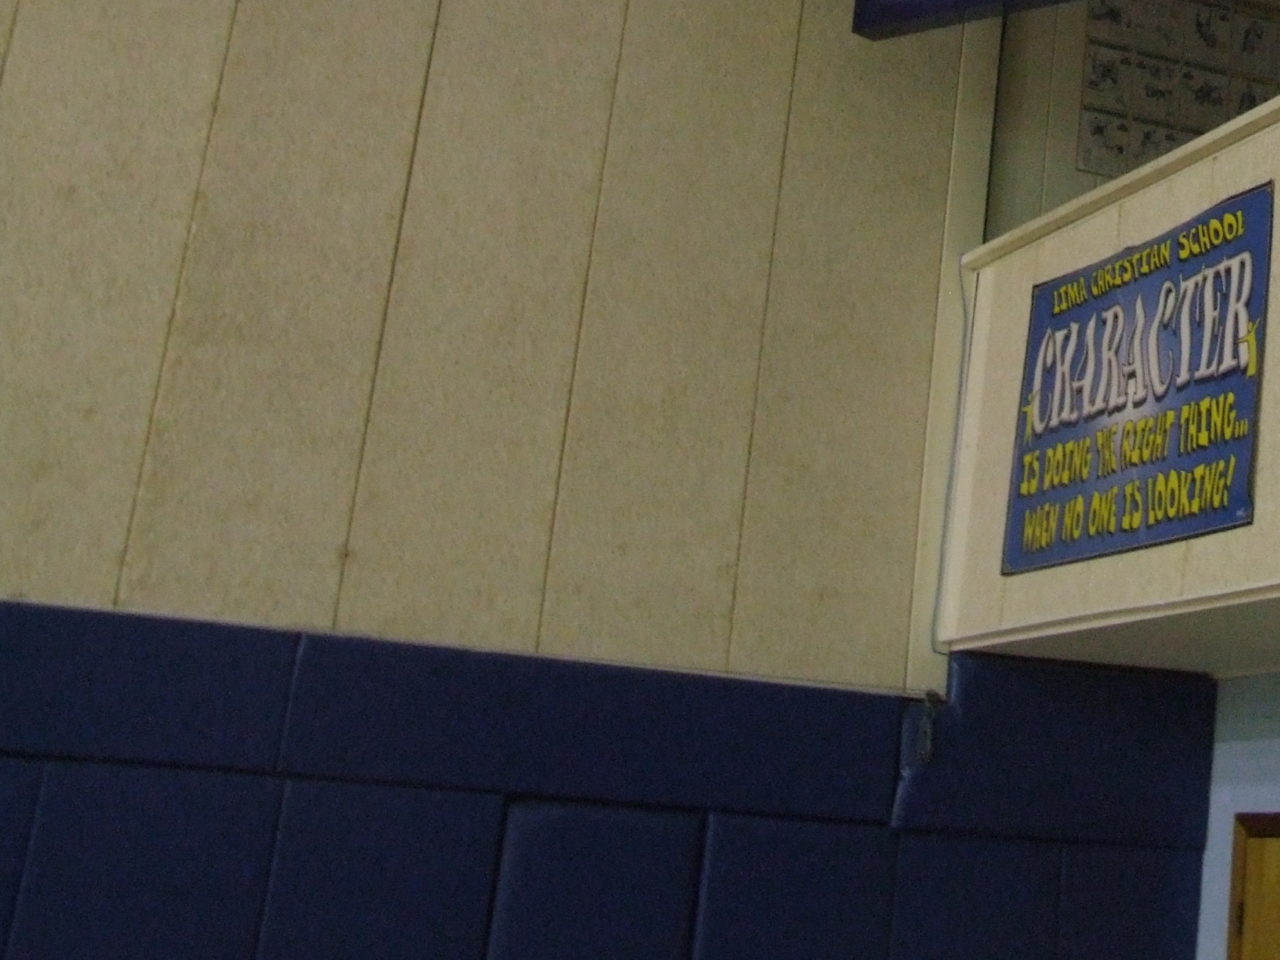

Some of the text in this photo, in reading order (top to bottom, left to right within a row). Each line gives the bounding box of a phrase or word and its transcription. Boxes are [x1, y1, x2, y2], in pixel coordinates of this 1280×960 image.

[1053, 210, 1245, 314] LIMA CHRISTIAN SCHOOL
[1031, 251, 1253, 435] CHARACTER
[1020, 451, 1040, 496] IS
[1043, 437, 1091, 490] DOING
[1096, 424, 1118, 477] THE
[1121, 410, 1175, 470] RIGHT
[1023, 454, 1236, 552] WHEN NO ONE IS LOOKING!
